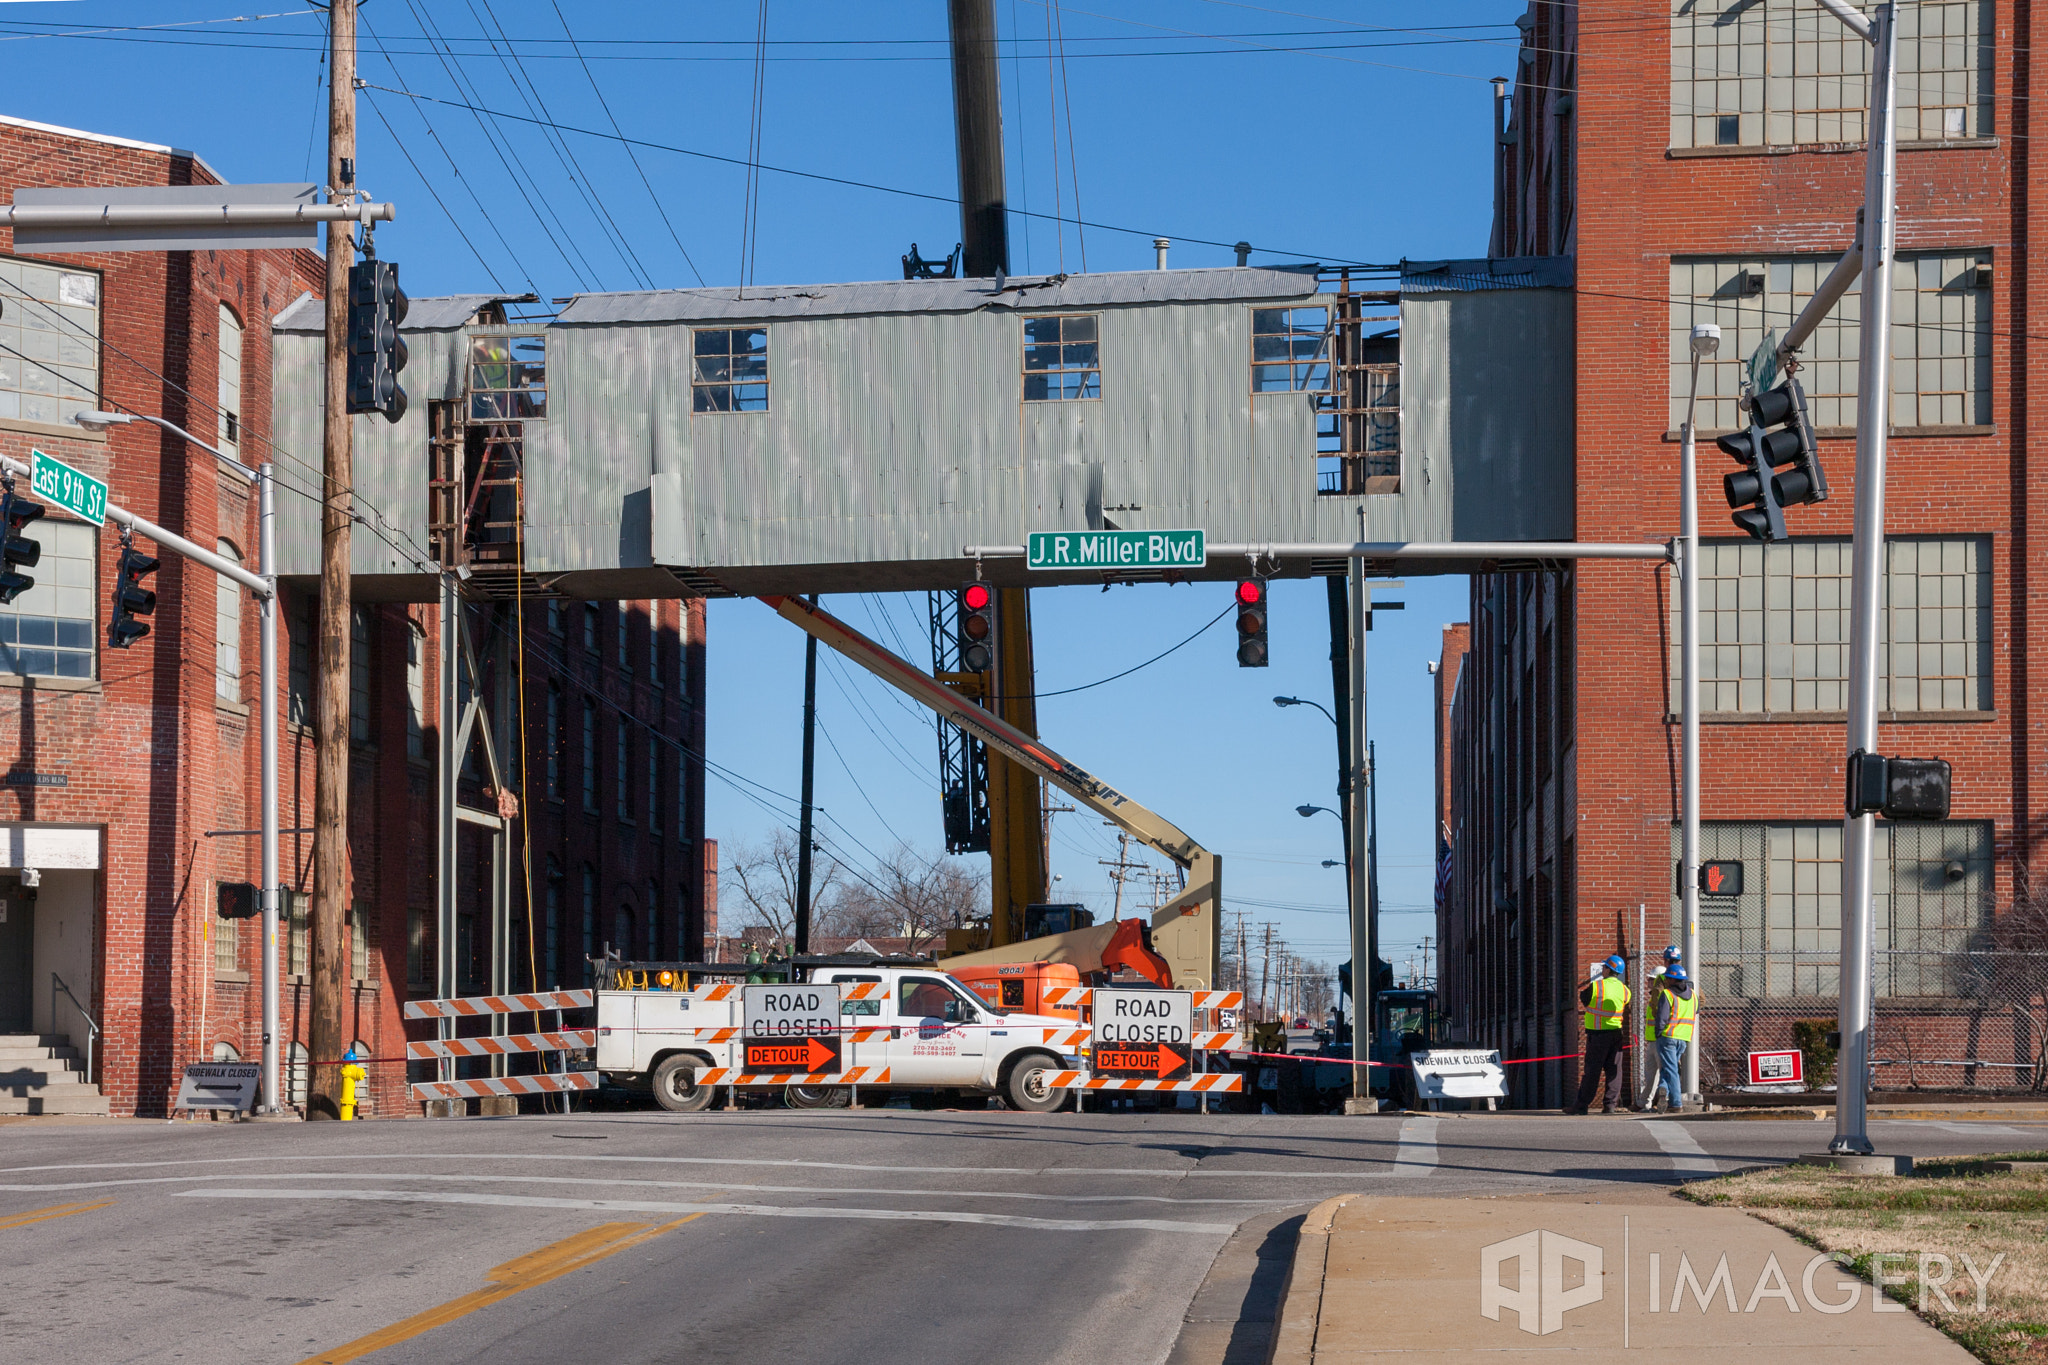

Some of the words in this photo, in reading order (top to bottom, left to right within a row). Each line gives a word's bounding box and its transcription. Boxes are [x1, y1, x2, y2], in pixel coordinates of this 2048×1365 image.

[33, 455, 59, 498] East
[63, 471, 84, 512] 9th
[87, 484, 104, 520] St.
[1148, 535, 1202, 562] Blvd.
[765, 994, 820, 1011] ROAD
[1115, 999, 1171, 1017] ROAD
[753, 1018, 832, 1037] CLOSED
[1102, 1024, 1182, 1043] CLOSED
[752, 1049, 809, 1062] DETOUR
[1101, 1053, 1160, 1067] DETOUR
[1415, 1056, 1460, 1066] SIDEWALK
[1462, 1054, 1497, 1065] CLOSED
[1772, 1056, 1791, 1064] UNITED
[187, 1067, 227, 1078] SIDEWALK
[227, 1068, 258, 1078] CLOSED
